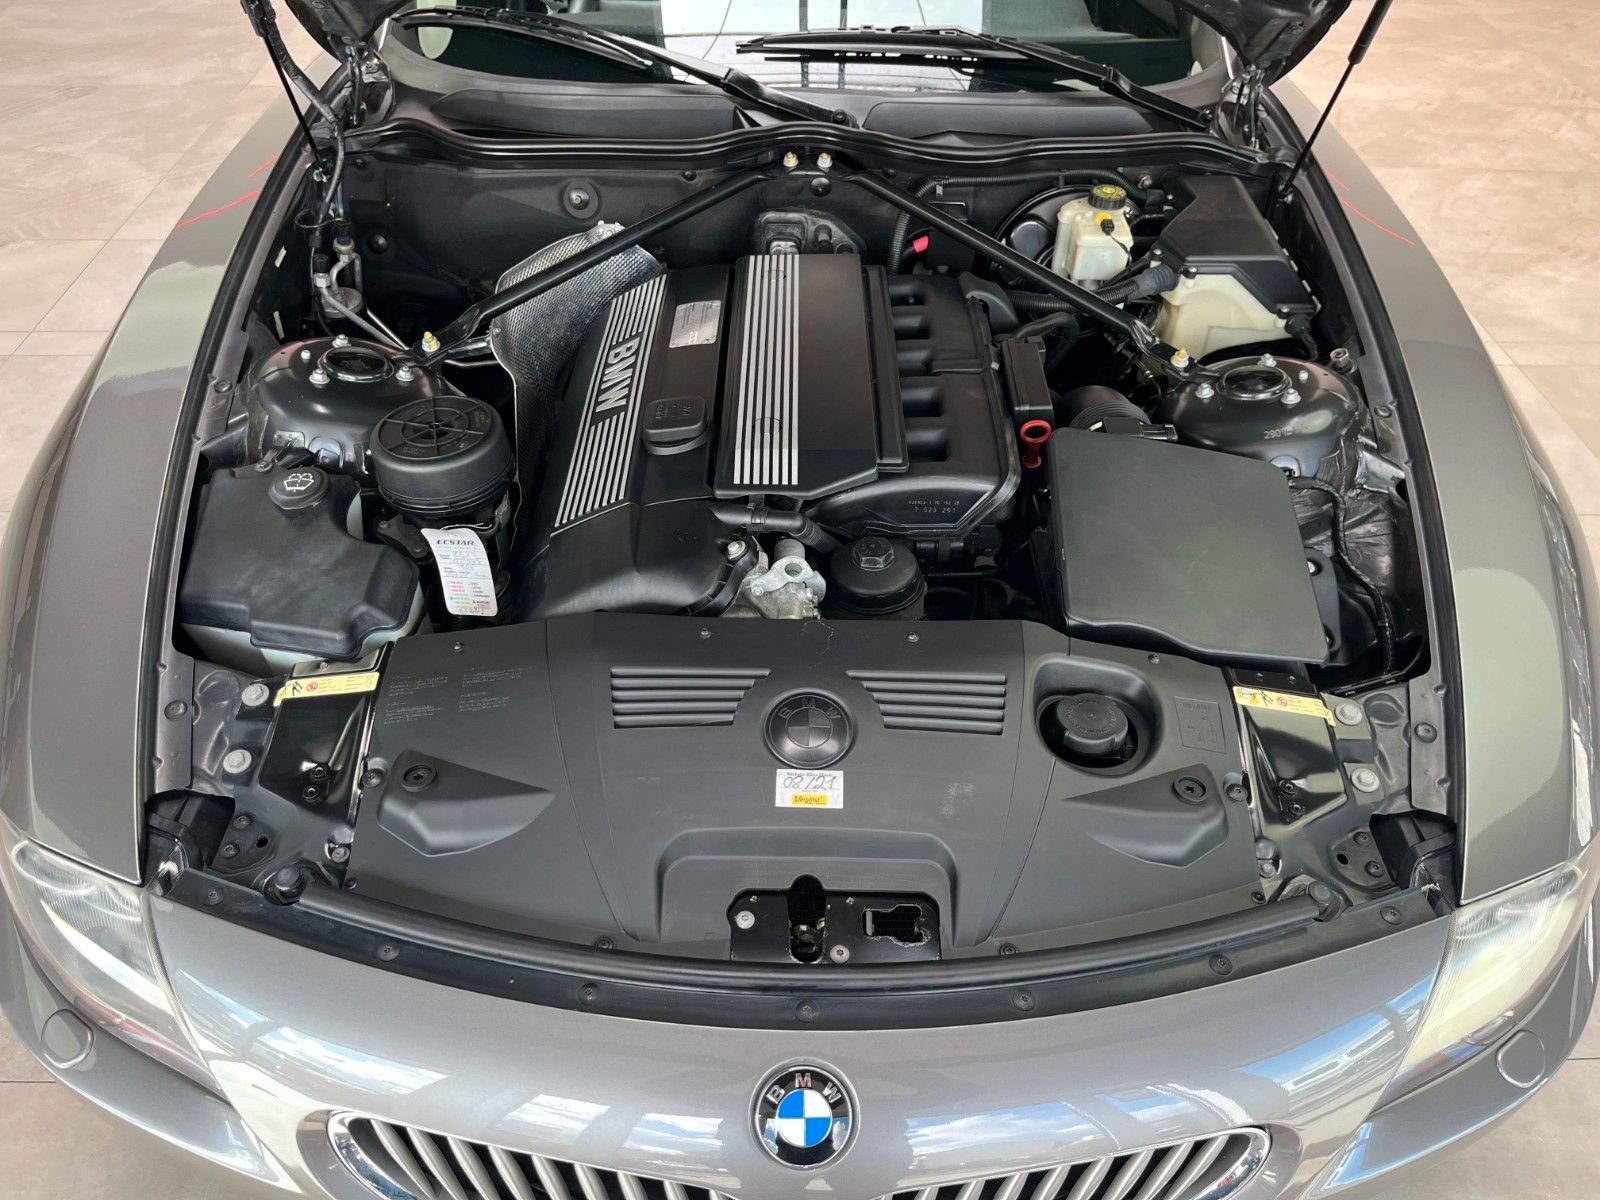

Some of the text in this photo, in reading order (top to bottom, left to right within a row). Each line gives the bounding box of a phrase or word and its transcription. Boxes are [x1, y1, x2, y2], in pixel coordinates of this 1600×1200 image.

[595, 337, 640, 413] BMW
[779, 697, 842, 720] BMW
[766, 1072, 842, 1105] BMW
